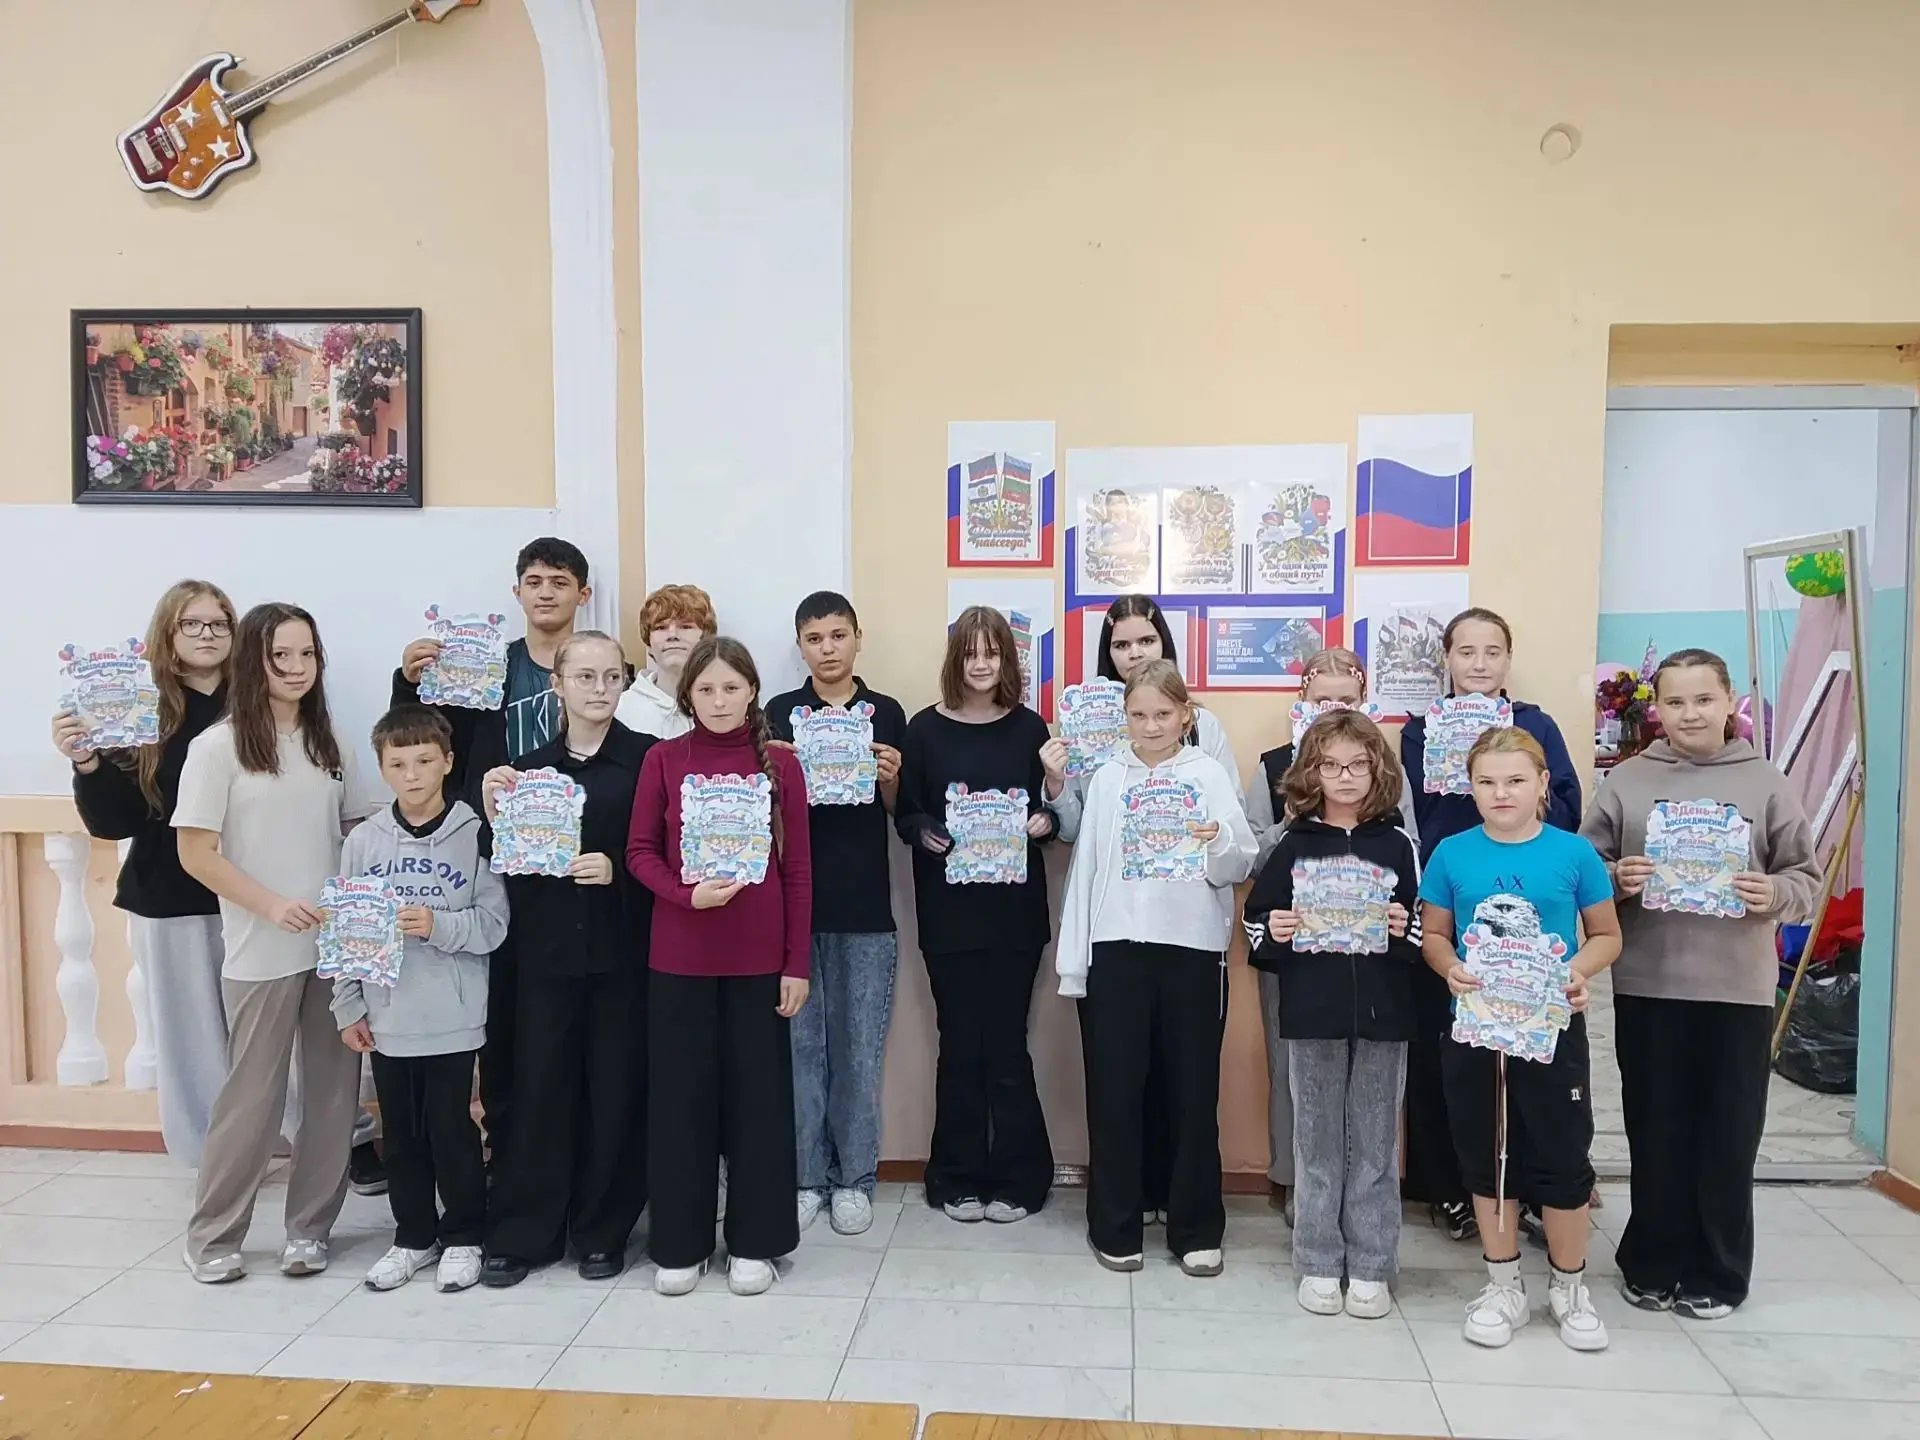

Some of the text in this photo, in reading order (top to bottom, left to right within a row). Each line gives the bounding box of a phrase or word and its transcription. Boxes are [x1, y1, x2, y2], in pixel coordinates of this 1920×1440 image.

[1269, 571, 1299, 579] общий
[1300, 571, 1324, 580] путь!
[455, 626, 480, 638] День
[1082, 684, 1106, 694] День
[1453, 701, 1482, 712] День
[823, 707, 848, 718] День
[525, 770, 553, 781] День
[711, 775, 741, 786] День
[1145, 778, 1172, 789] День
[1679, 805, 1710, 817] День
[364, 857, 468, 891] EARSON
[344, 882, 372, 893] День
[395, 885, 446, 897] OS.CO.
[1501, 938, 1533, 953] День
